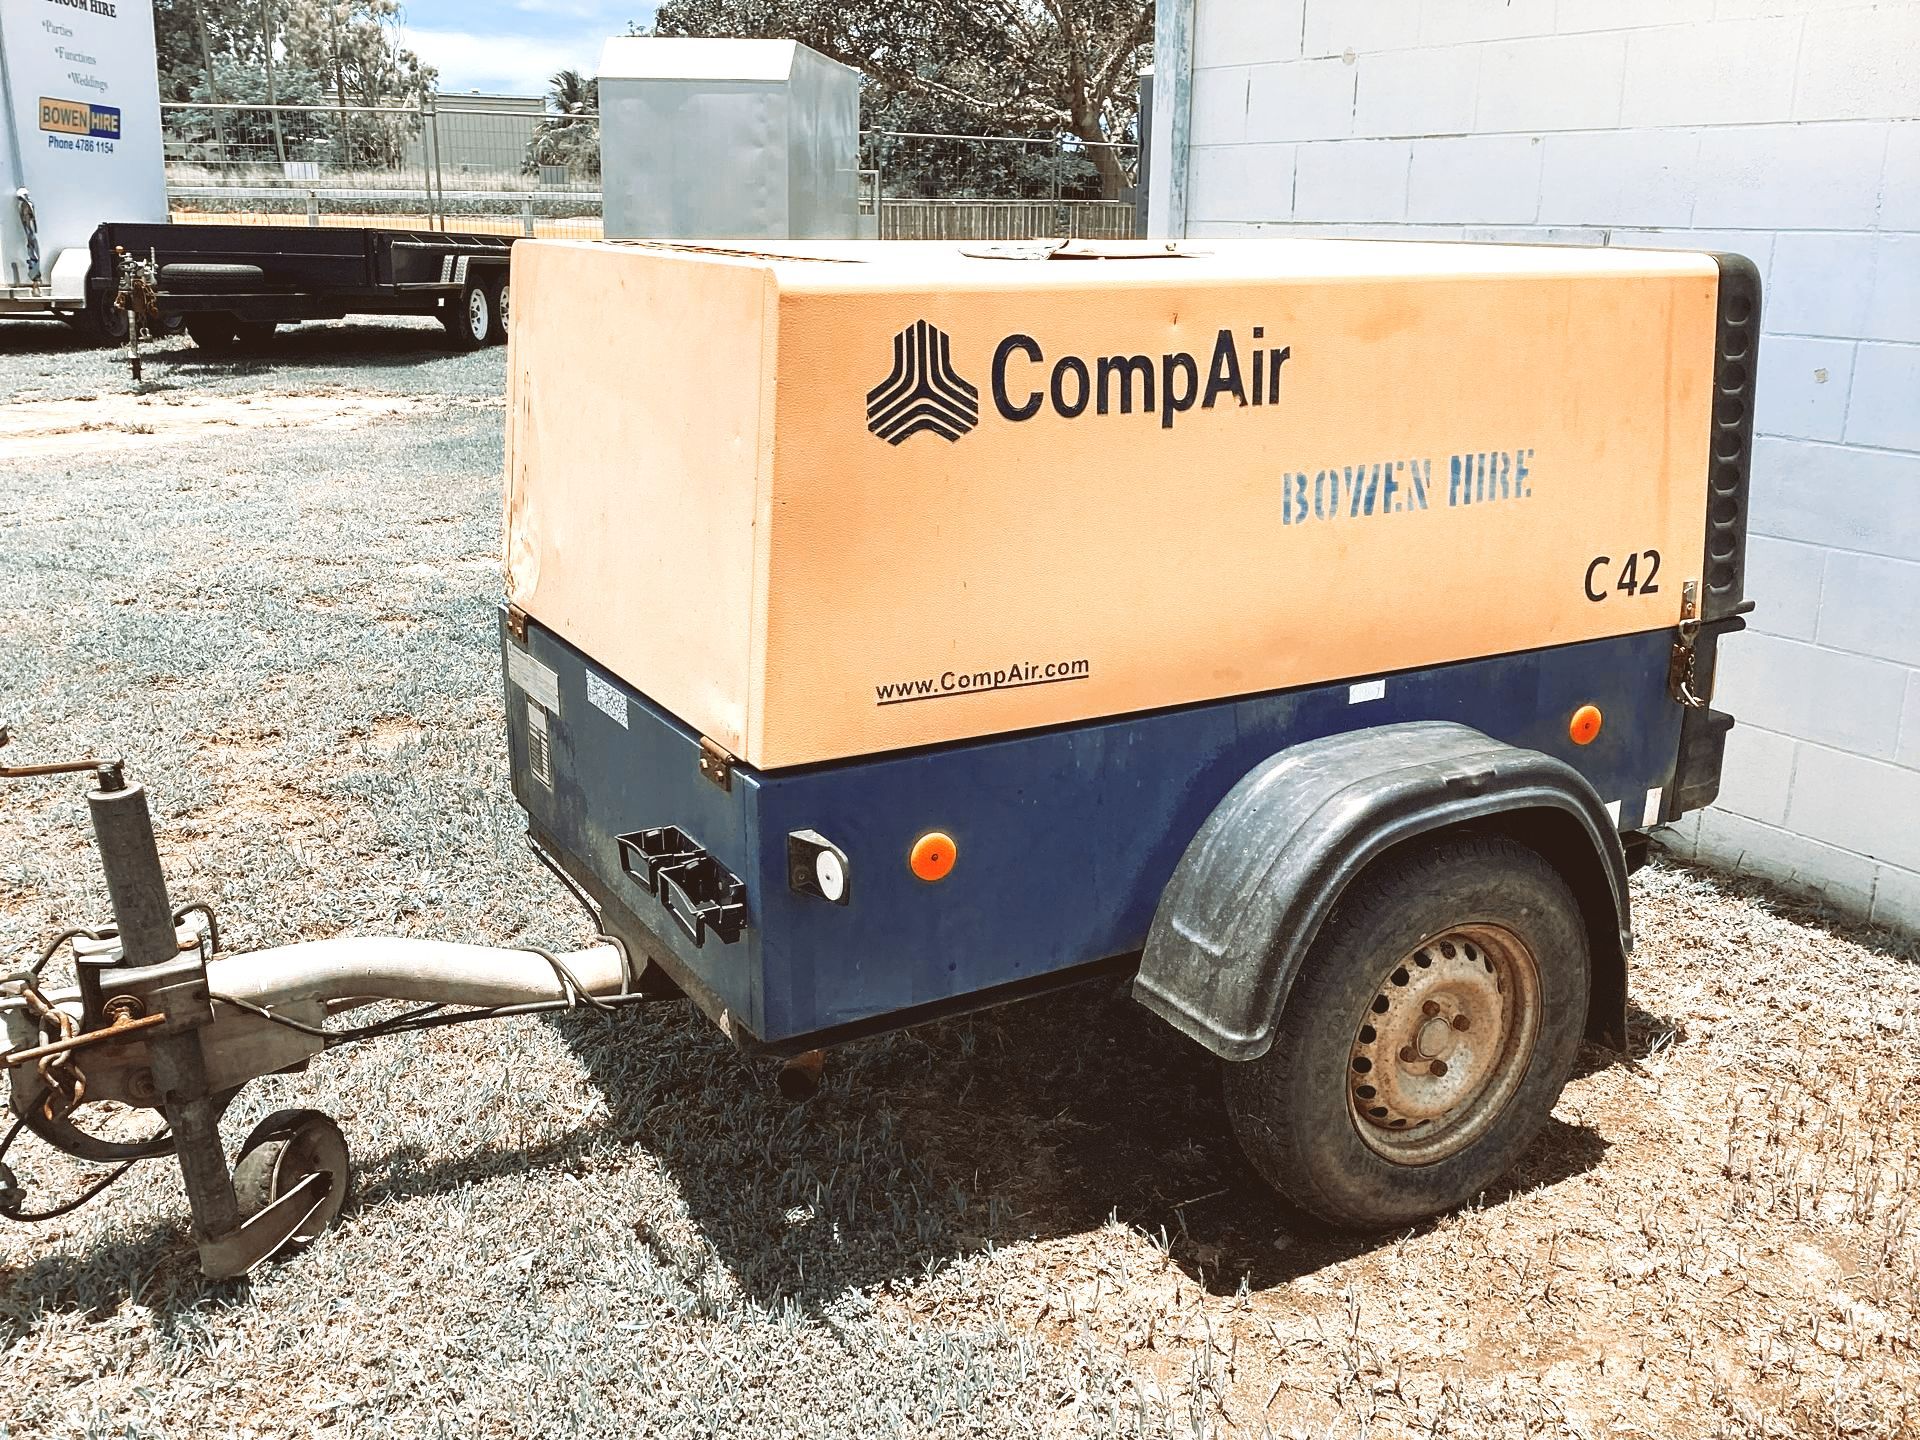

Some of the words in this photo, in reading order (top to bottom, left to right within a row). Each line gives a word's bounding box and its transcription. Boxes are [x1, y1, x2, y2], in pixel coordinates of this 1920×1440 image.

[90, 0, 116, 18] HIRE
[43, 105, 88, 128] BOWEN
[91, 111, 119, 133] HIRE
[48, 135, 74, 150] Phone
[75, 139, 94, 153] 4786
[96, 141, 114, 154] 1154
[991, 326, 1291, 429] CompAir
[1283, 458, 1431, 525] BOWEN
[1449, 448, 1534, 507] HIRE
[1584, 556, 1611, 602] C
[1617, 549, 1661, 597] 42
[875, 659, 1090, 700] www.CompAir.com
